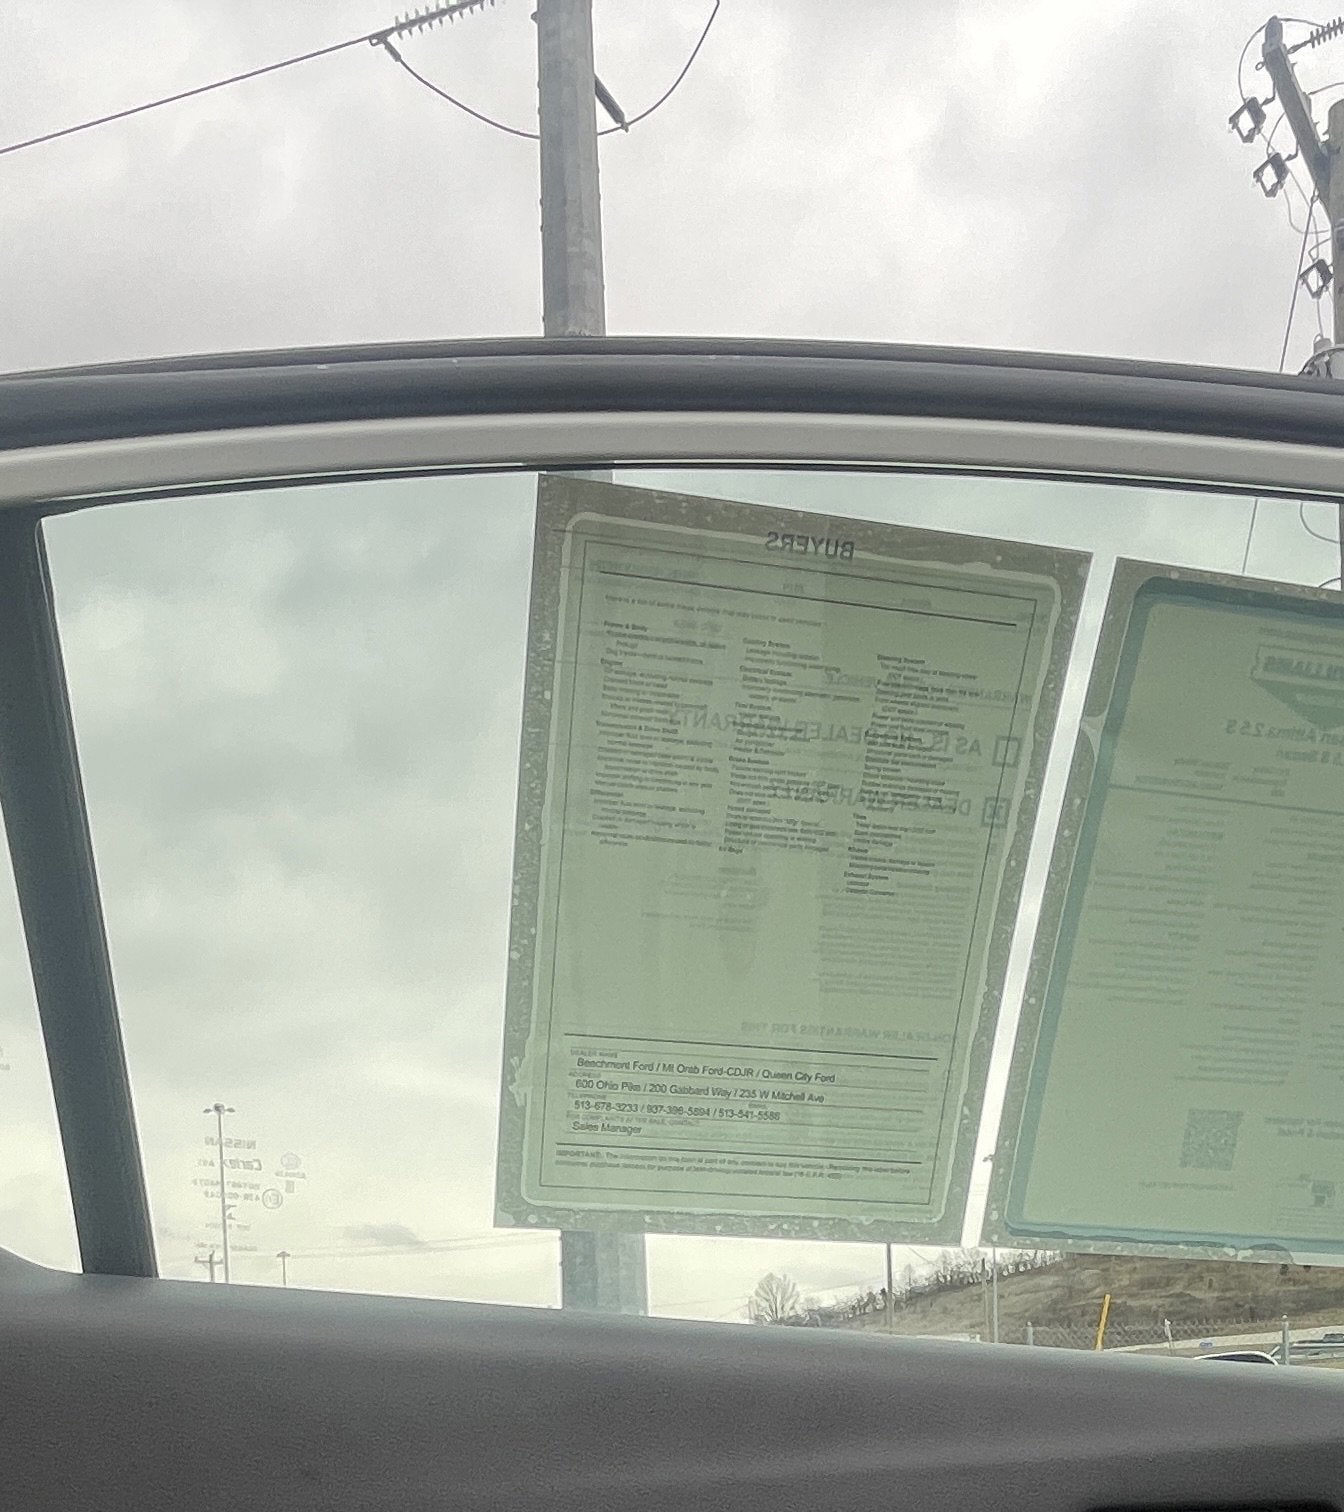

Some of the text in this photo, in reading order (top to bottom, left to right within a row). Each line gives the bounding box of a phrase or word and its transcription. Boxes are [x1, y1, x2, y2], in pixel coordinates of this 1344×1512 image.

[577, 1057, 631, 1070] Beechmont
[633, 1061, 654, 1071] Ford
[676, 1063, 699, 1074] Orab
[762, 1069, 793, 1080] Queen
[794, 1071, 812, 1083] City
[814, 1072, 836, 1083] Ford
[595, 1080, 619, 1090] Ohio
[759, 1090, 769, 1100] W
[572, 1121, 642, 1136] Sales Manager
